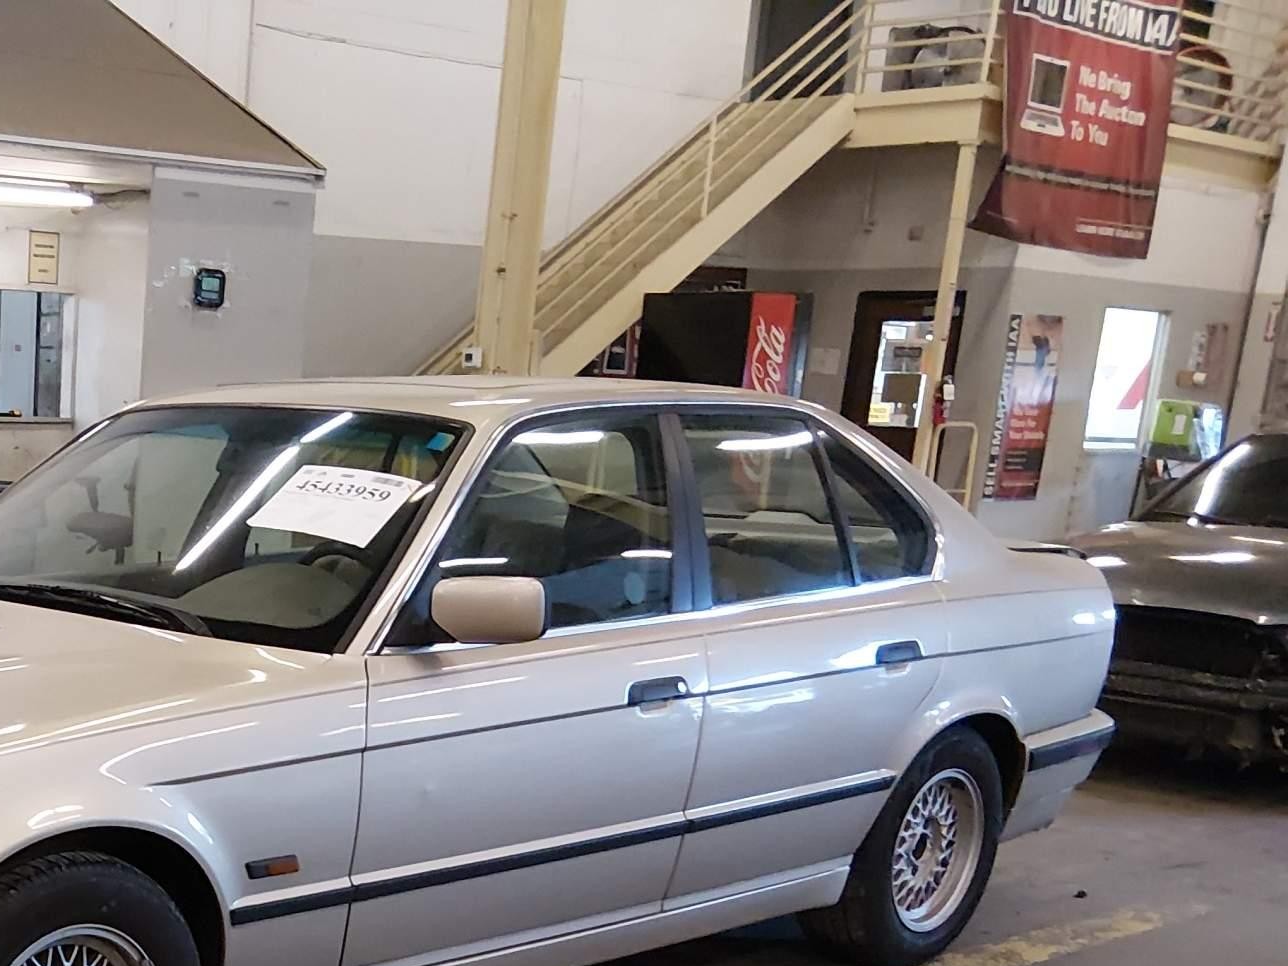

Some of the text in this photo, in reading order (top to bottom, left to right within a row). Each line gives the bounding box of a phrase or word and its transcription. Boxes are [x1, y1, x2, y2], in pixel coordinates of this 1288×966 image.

[1063, 0, 1098, 28] LIVE
[1098, 0, 1144, 40] FROM
[1097, 70, 1131, 100] Bring
[1075, 92, 1146, 127] The Auction
[1070, 120, 1109, 146] To You
[751, 314, 786, 393] Cola
[983, 459, 999, 496] SELL
[1007, 318, 1022, 347] IAA
[295, 479, 392, 502] 45433959
